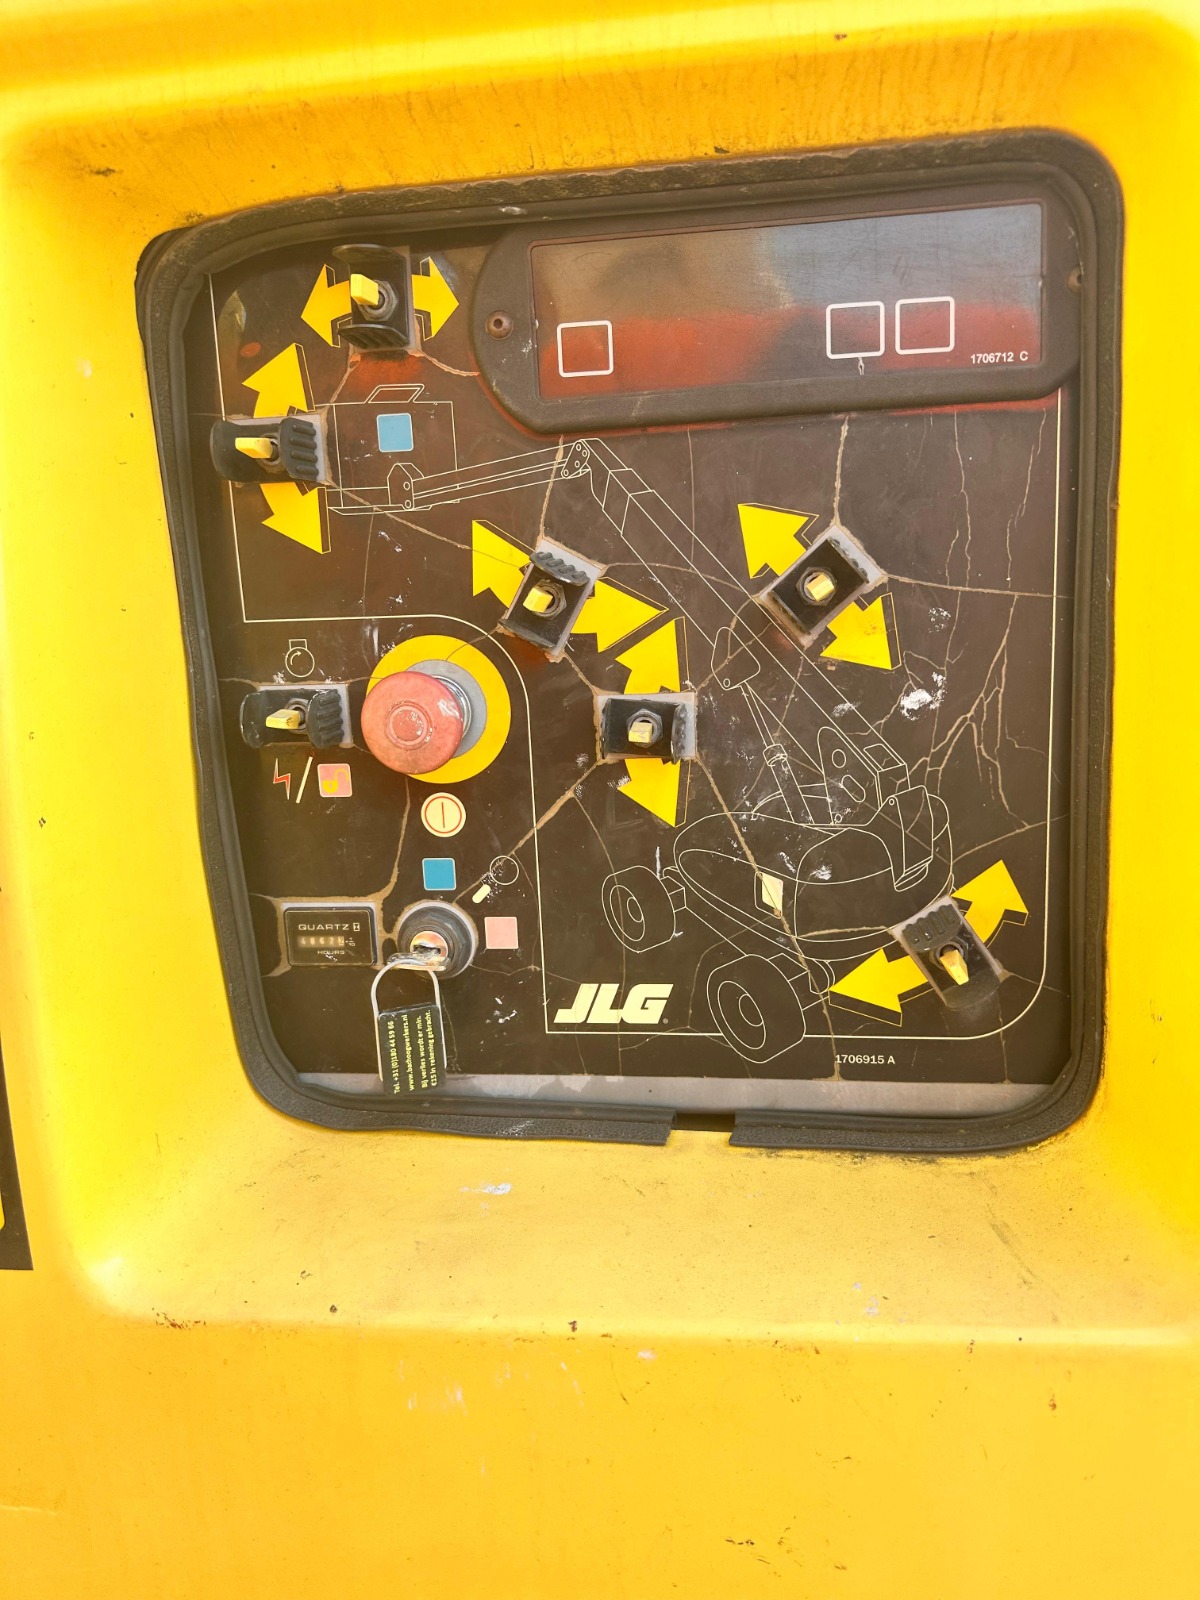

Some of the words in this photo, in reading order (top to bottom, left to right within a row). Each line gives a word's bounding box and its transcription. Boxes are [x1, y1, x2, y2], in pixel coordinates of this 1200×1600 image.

[970, 351, 1015, 364] 1706712
[1019, 350, 1029, 361] C
[553, 983, 674, 1025] JLG
[387, 1021, 394, 1029] 66
[425, 1010, 434, 1038] gebracht.
[388, 1030, 395, 1038] 59
[418, 1030, 423, 1038] er
[389, 1039, 395, 1047] 44
[417, 1038, 425, 1057] wordt
[390, 1048, 399, 1068] (0)180
[401, 1014, 414, 1091] www.bachoogwerkers.nl
[835, 1054, 885, 1064] 1706915
[887, 1055, 896, 1065] A
